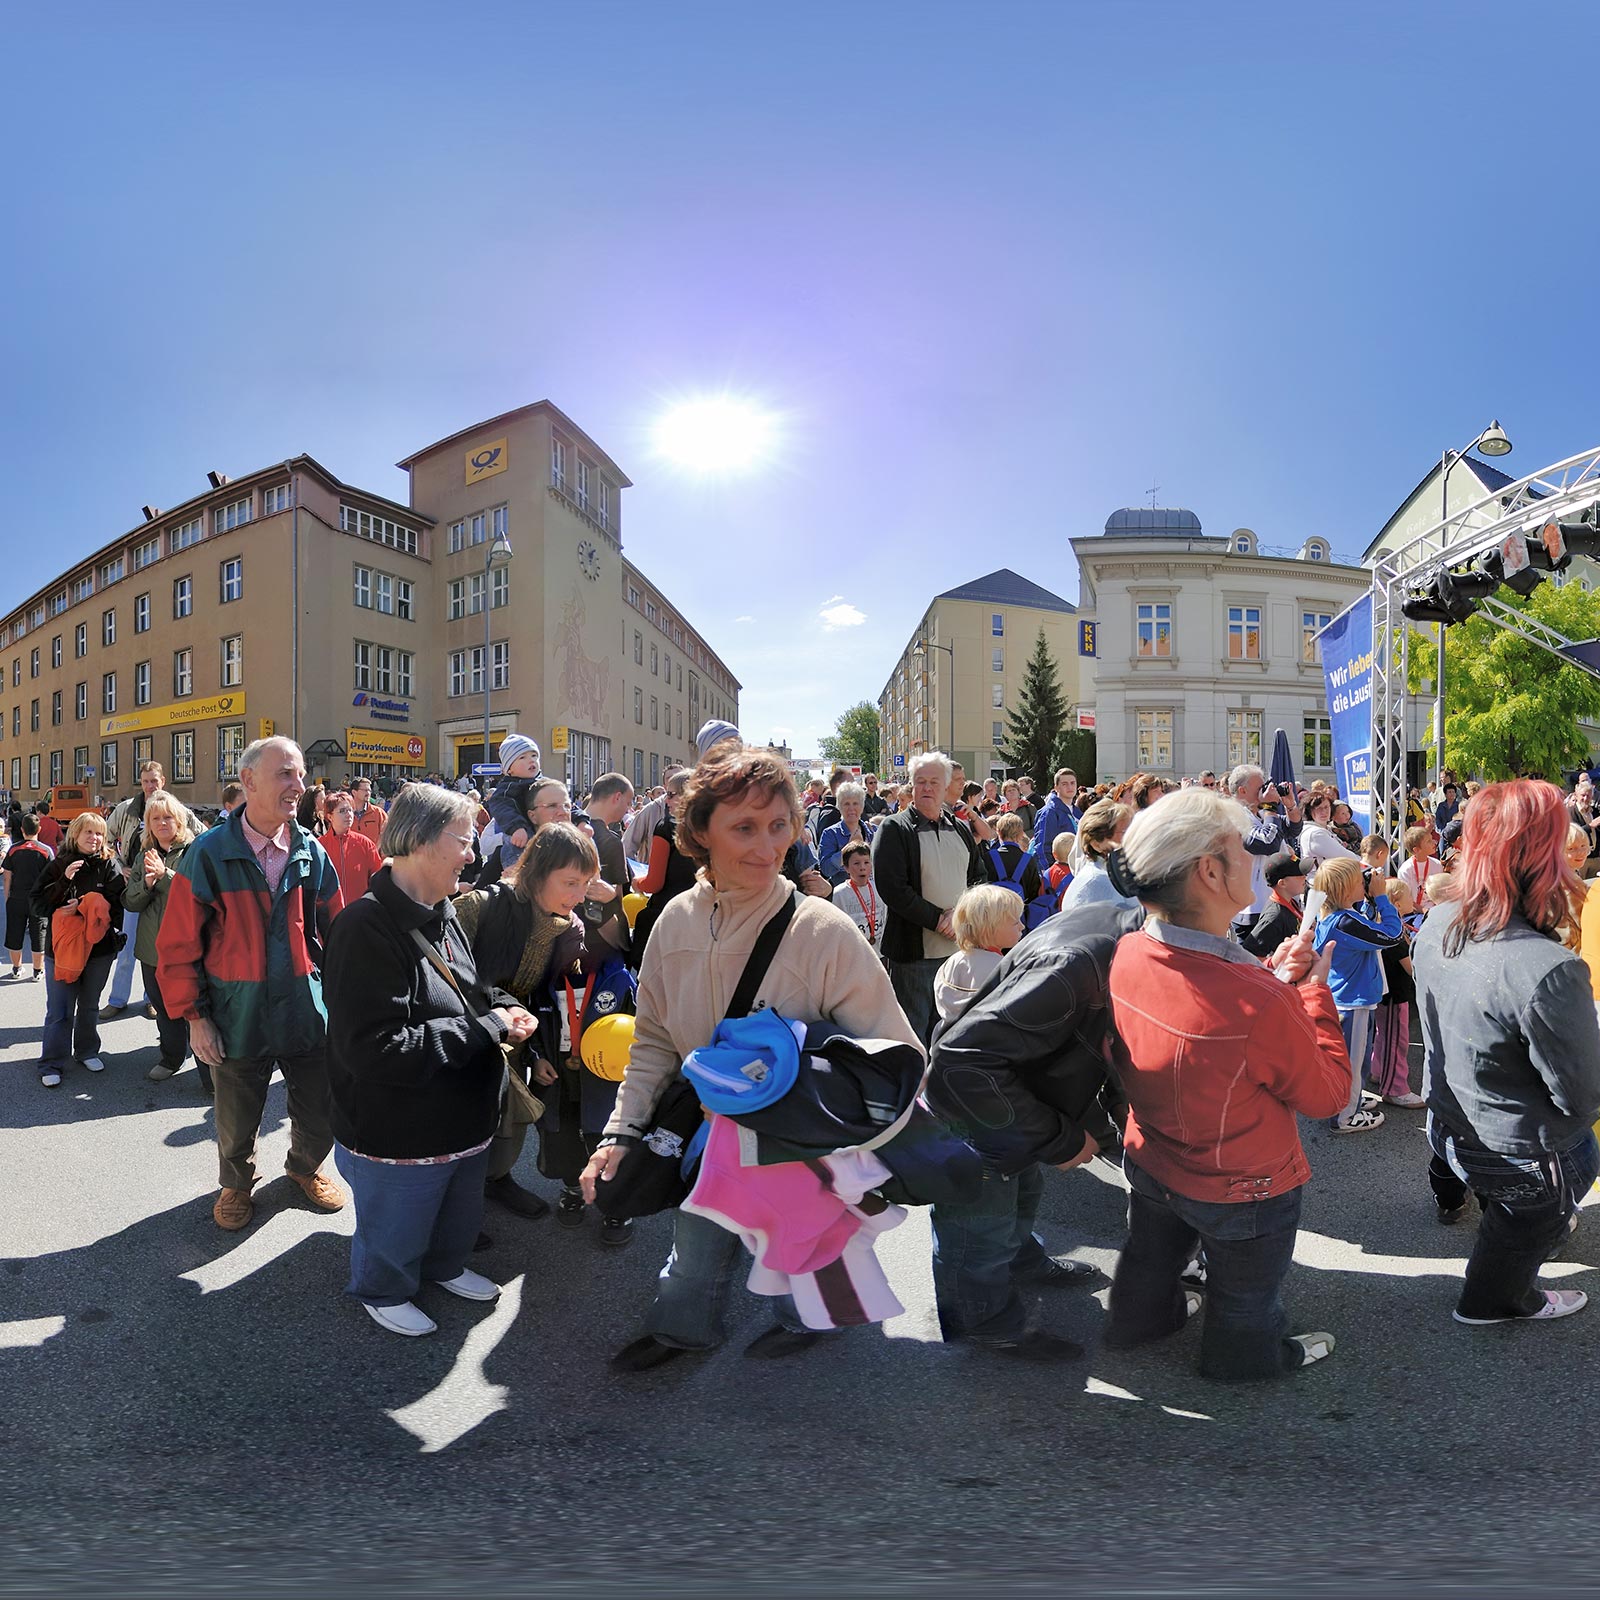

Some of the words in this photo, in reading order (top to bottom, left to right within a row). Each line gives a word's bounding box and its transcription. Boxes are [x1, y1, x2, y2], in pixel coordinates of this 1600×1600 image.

[1084, 624, 1093, 652] KKH
[1330, 666, 1348, 689] Wir
[1348, 651, 1373, 680] liebe
[1332, 693, 1349, 714] die
[1349, 677, 1373, 708] Lausi
[170, 706, 200, 719] Deutsche
[201, 705, 217, 714] Post
[116, 719, 141, 729] Postbank
[350, 741, 405, 754] Privatkredit
[1352, 757, 1367, 773] Radio
